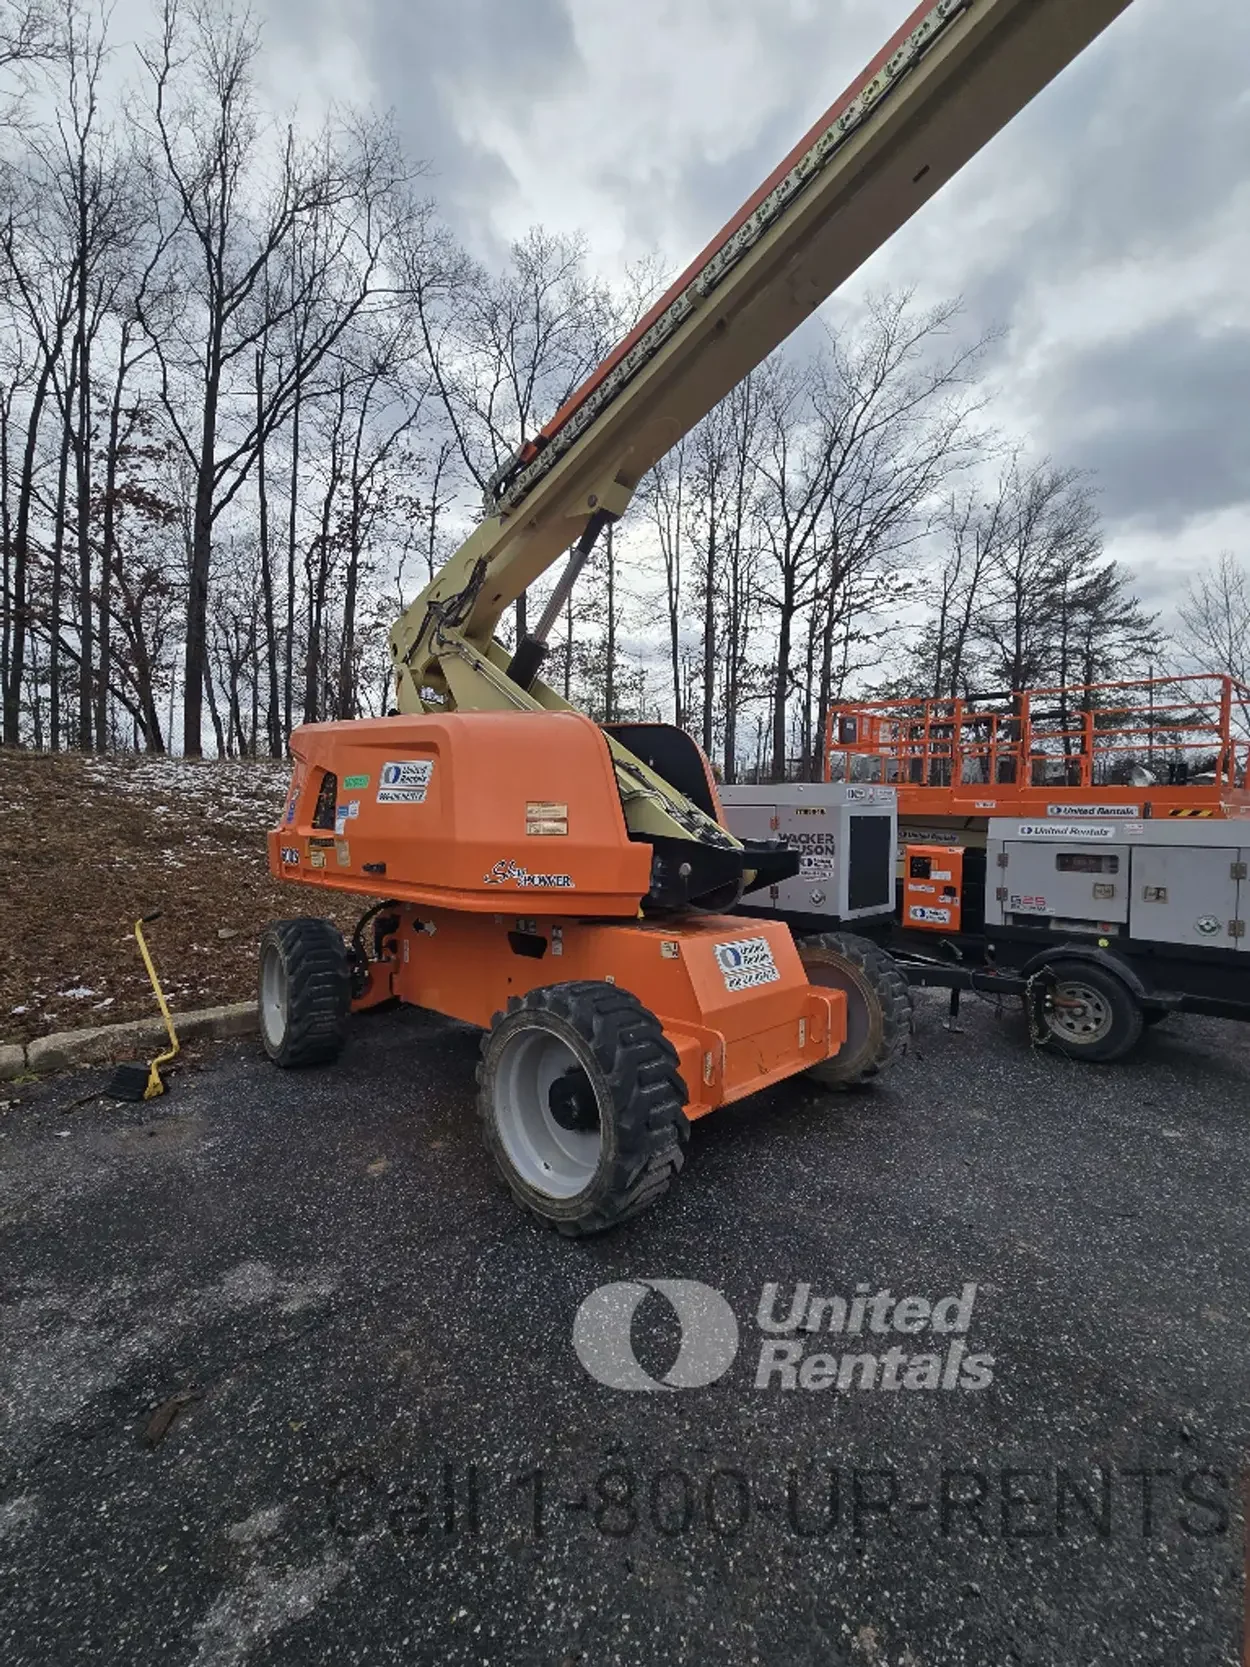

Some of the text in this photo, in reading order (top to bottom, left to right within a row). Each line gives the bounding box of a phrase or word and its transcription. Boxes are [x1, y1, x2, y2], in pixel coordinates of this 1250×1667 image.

[1063, 806, 1134, 815] United Rentals
[1034, 826, 1068, 836] United
[779, 832, 835, 845] WACKER
